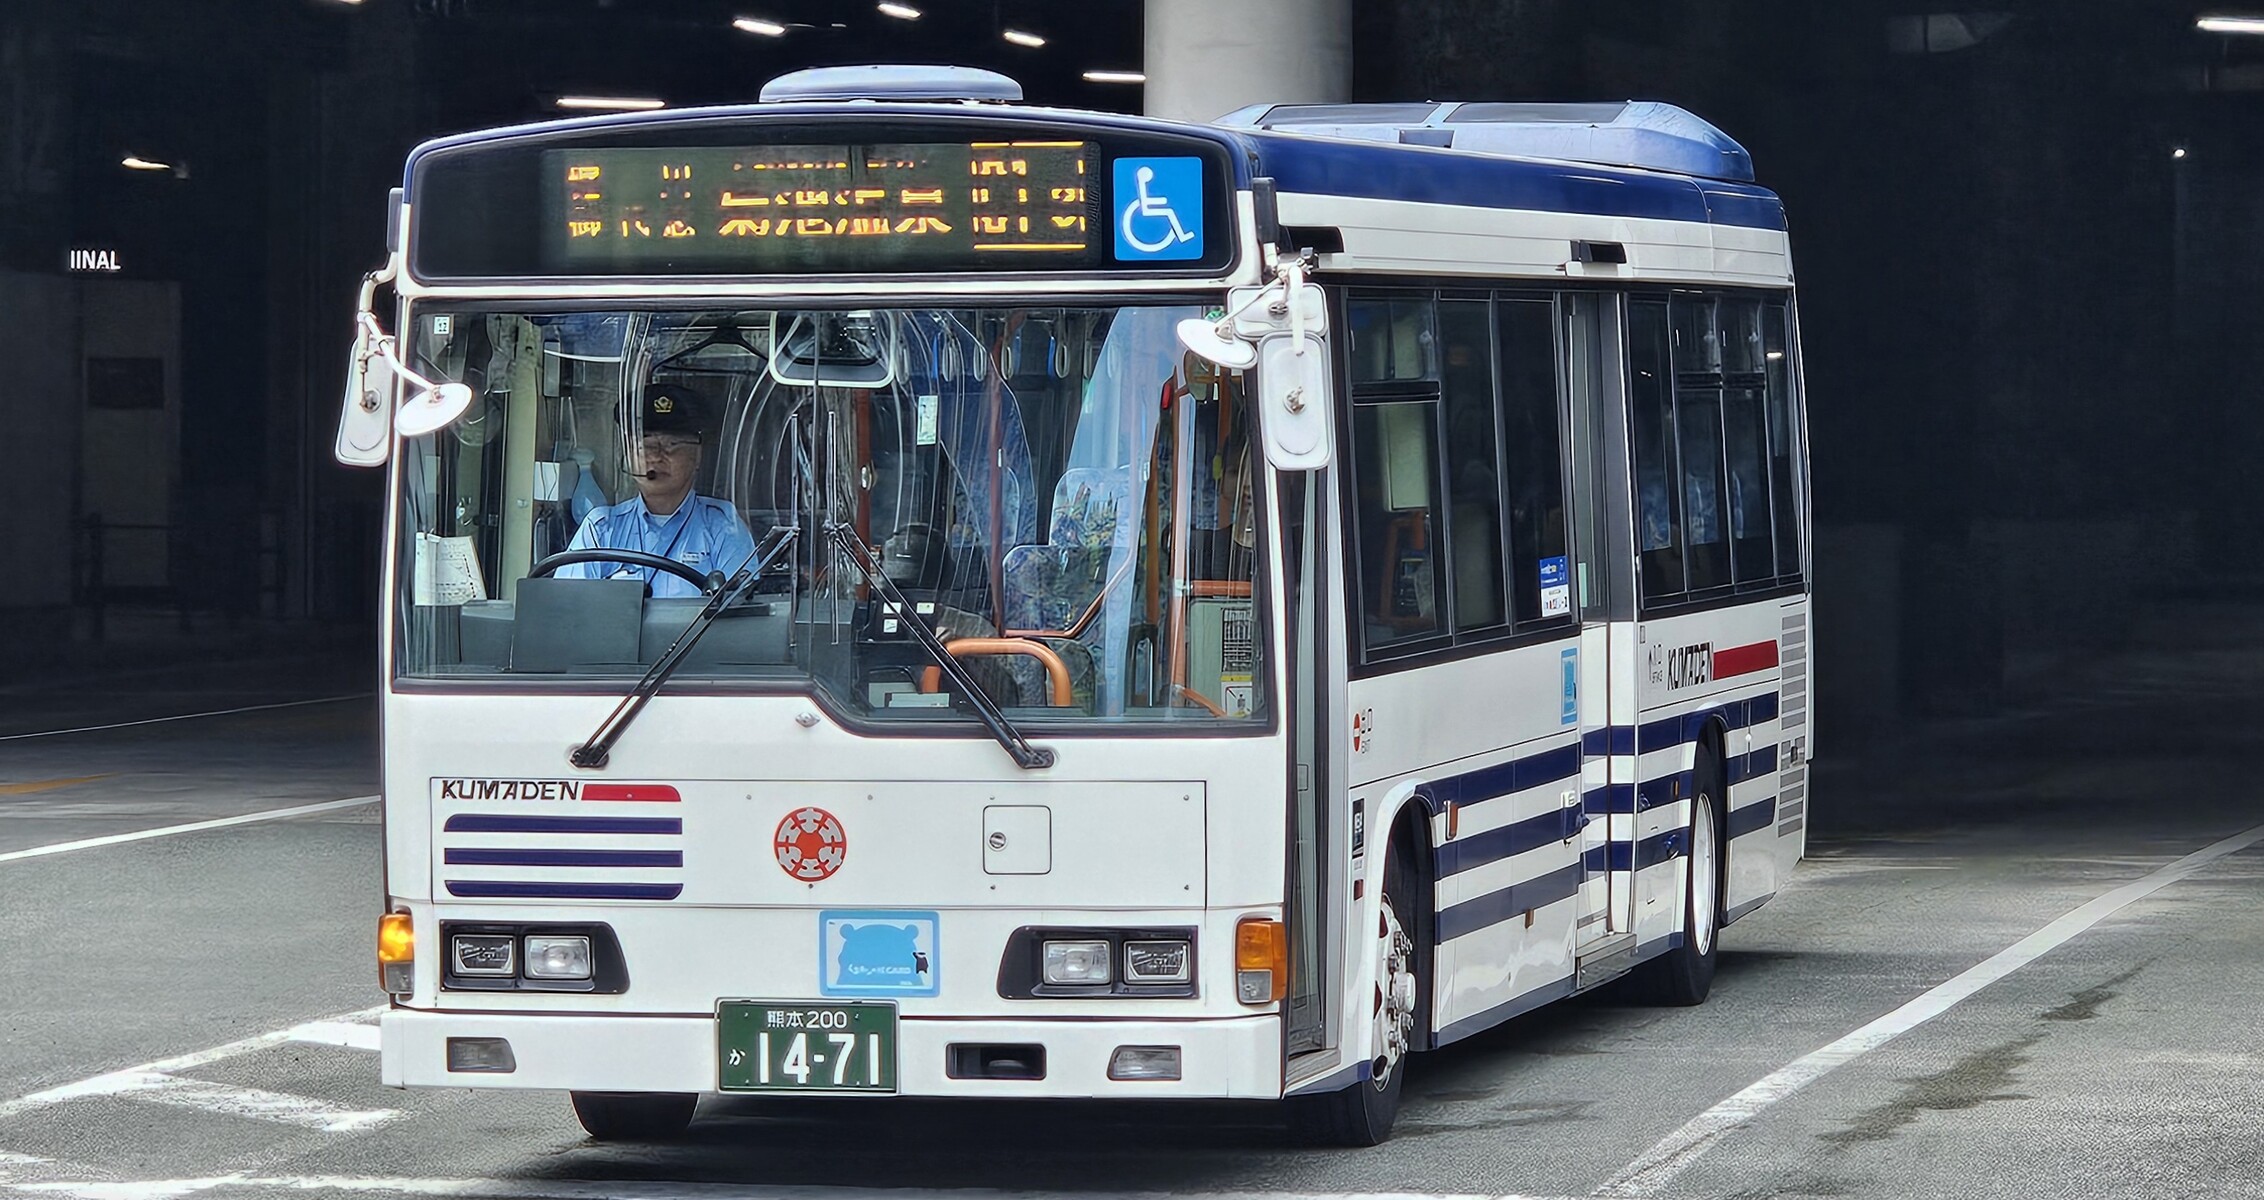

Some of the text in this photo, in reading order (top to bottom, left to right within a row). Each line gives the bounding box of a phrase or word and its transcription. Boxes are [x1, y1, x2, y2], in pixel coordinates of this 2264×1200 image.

[441, 779, 579, 800] KUMADEN
[728, 1032, 880, 1085] か 14-71
